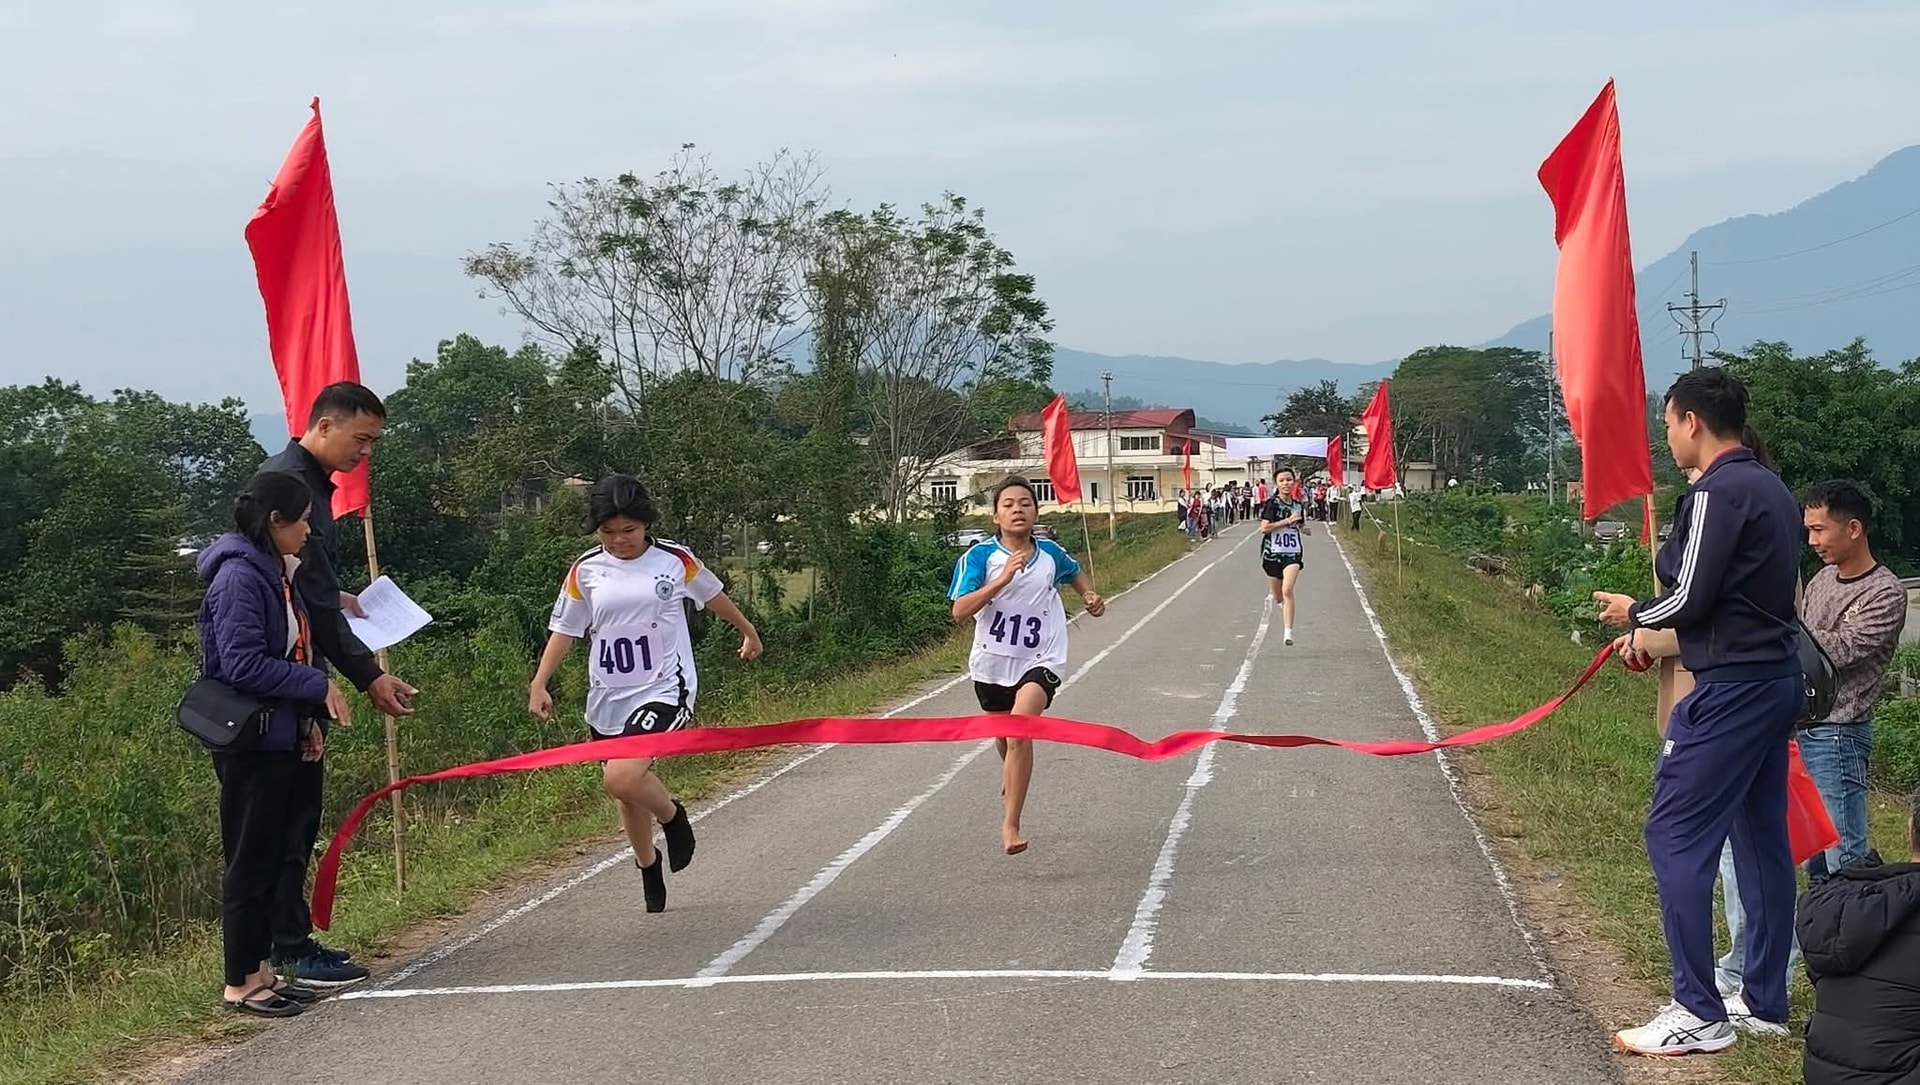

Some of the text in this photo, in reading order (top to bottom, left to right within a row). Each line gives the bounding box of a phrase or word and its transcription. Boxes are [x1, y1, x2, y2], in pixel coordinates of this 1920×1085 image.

[1275, 533, 1297, 547] 405
[989, 611, 1042, 648] 413
[600, 635, 652, 674] 401
